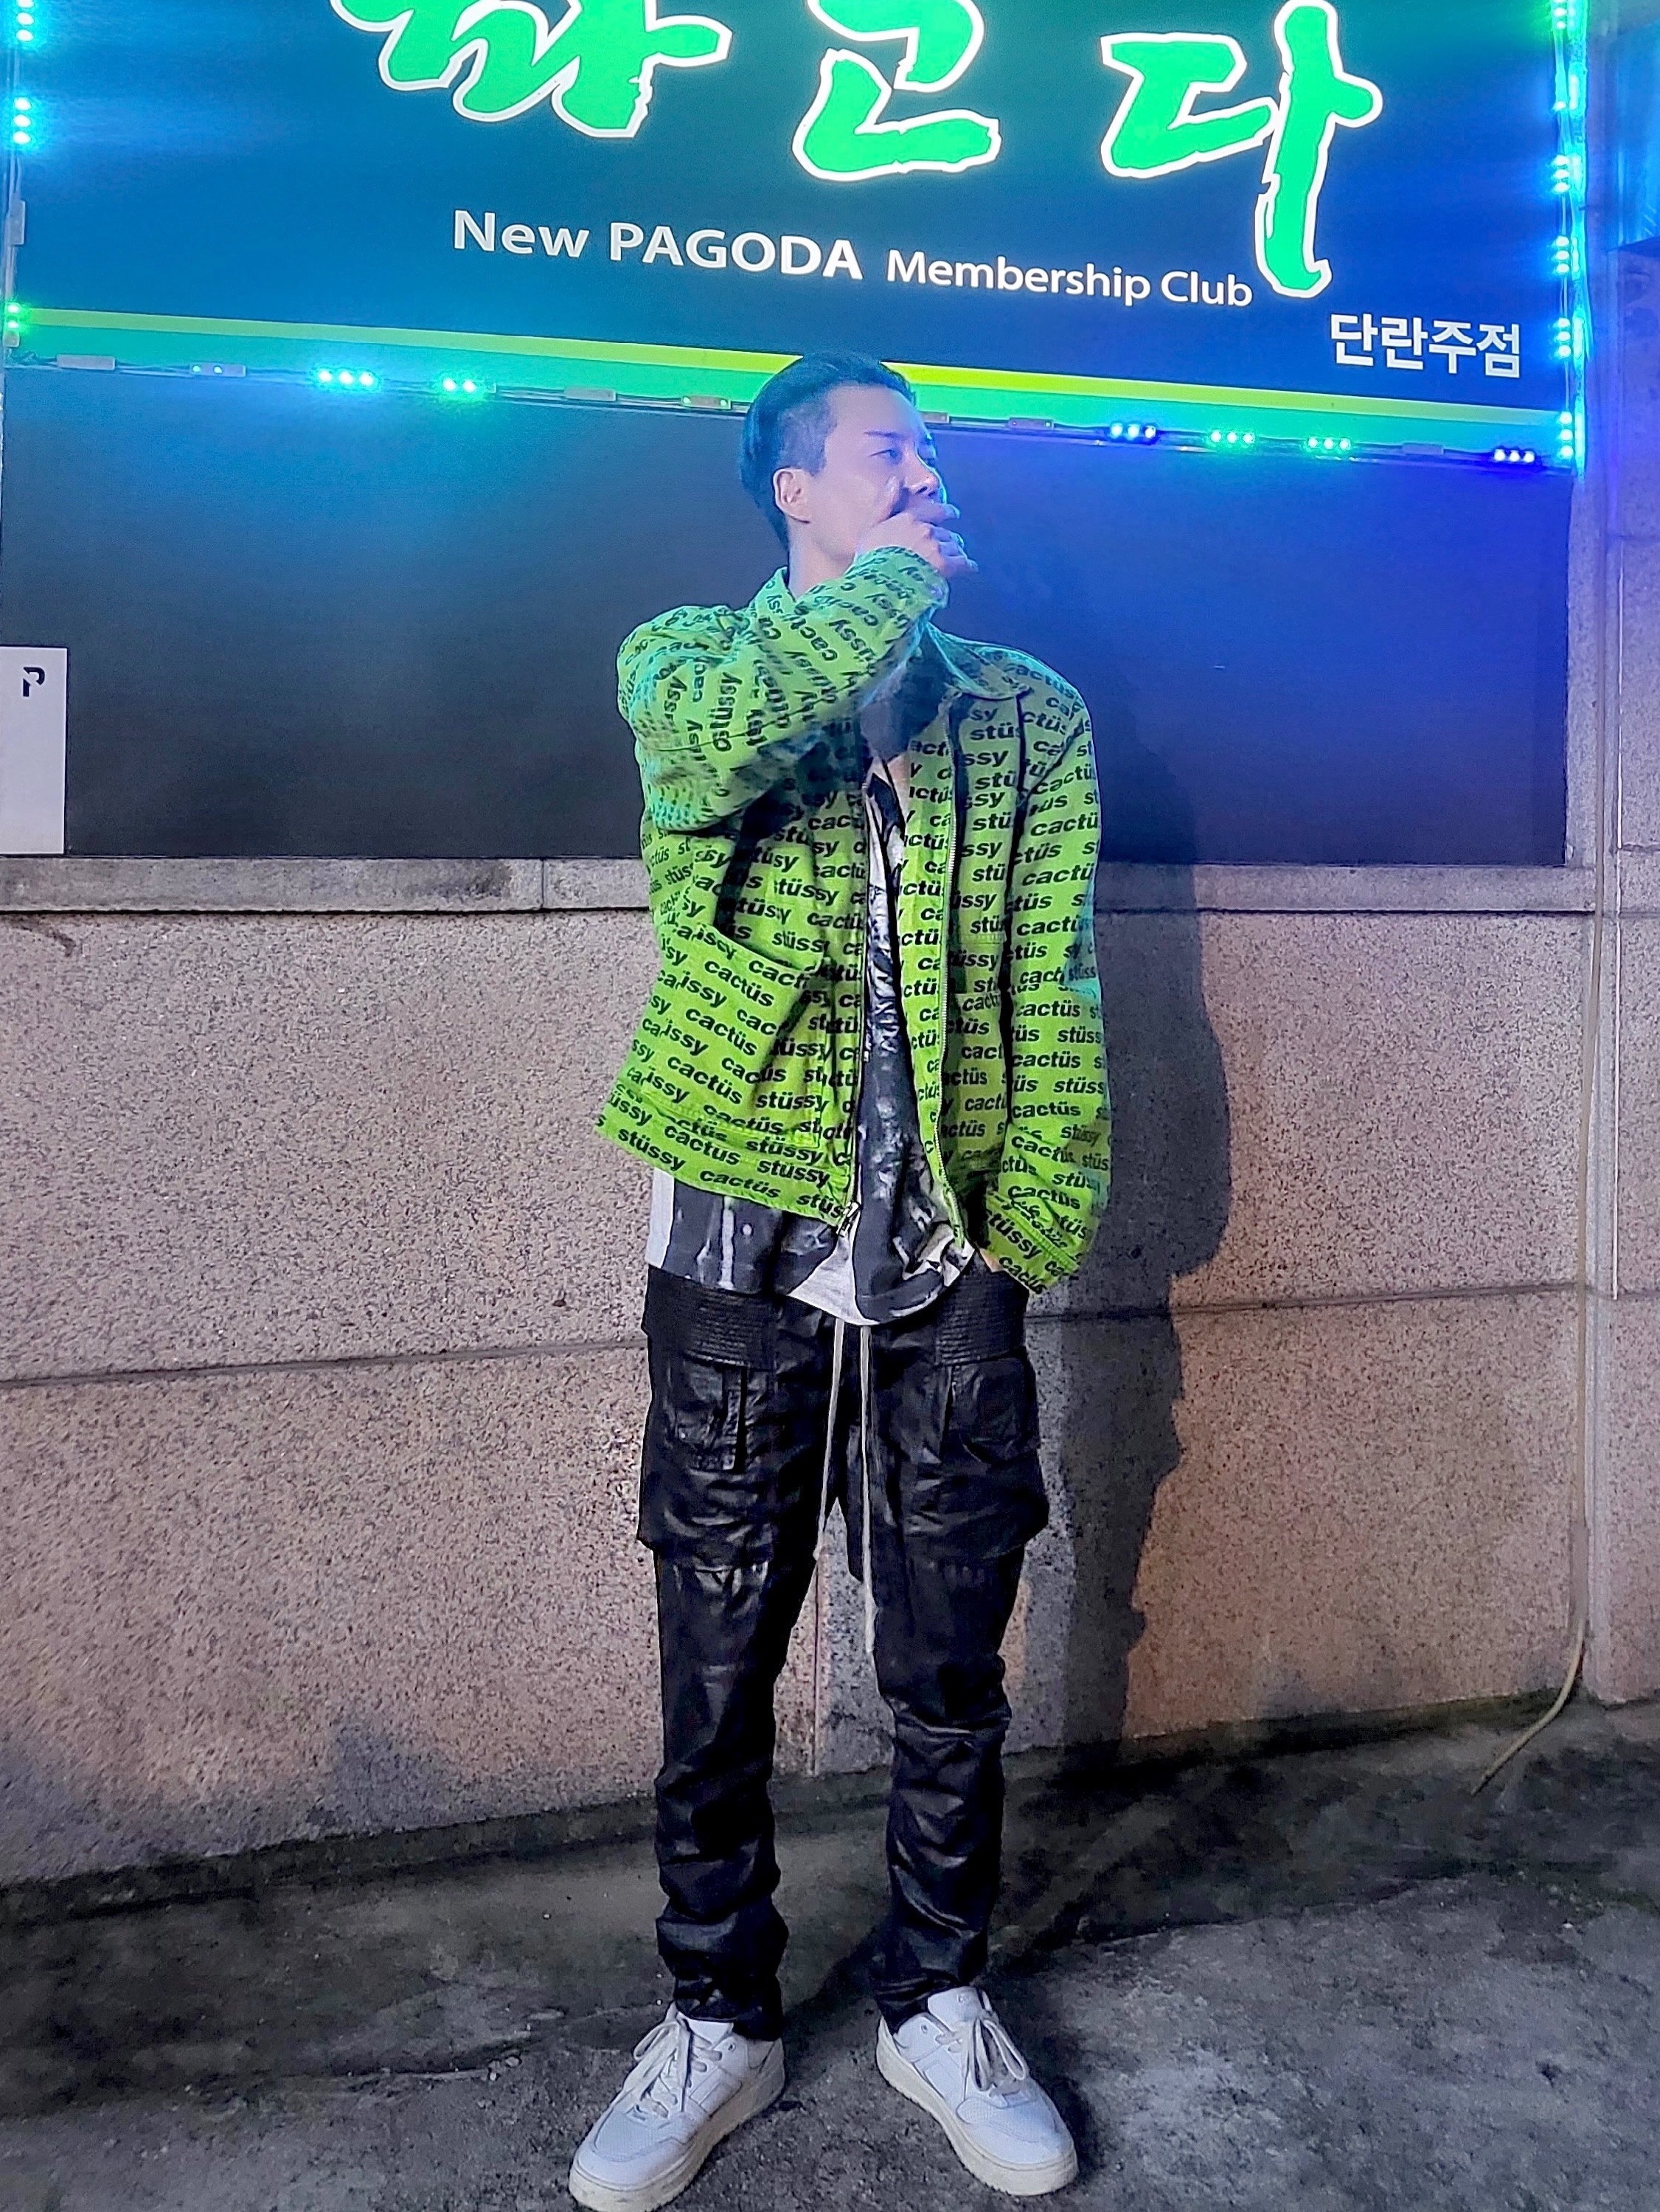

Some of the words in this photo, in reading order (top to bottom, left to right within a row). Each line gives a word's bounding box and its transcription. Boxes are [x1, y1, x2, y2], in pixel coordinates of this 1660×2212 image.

[453, 209, 590, 259] New
[608, 221, 864, 281] PAGODA
[886, 249, 1152, 308] Membership
[1160, 270, 1253, 308] Club
[1330, 313, 1521, 380] 단란주점
[1030, 812, 1098, 836] cactü
[704, 960, 774, 1007] cactüs
[685, 1008, 757, 1056] cactüs
[667, 1056, 743, 1104] cactüs
[1013, 1051, 1080, 1069] cactüs
[1013, 1101, 1081, 1118] cactüs
[618, 1129, 686, 1171] stüssy
[700, 1171, 781, 1199] cactüs
